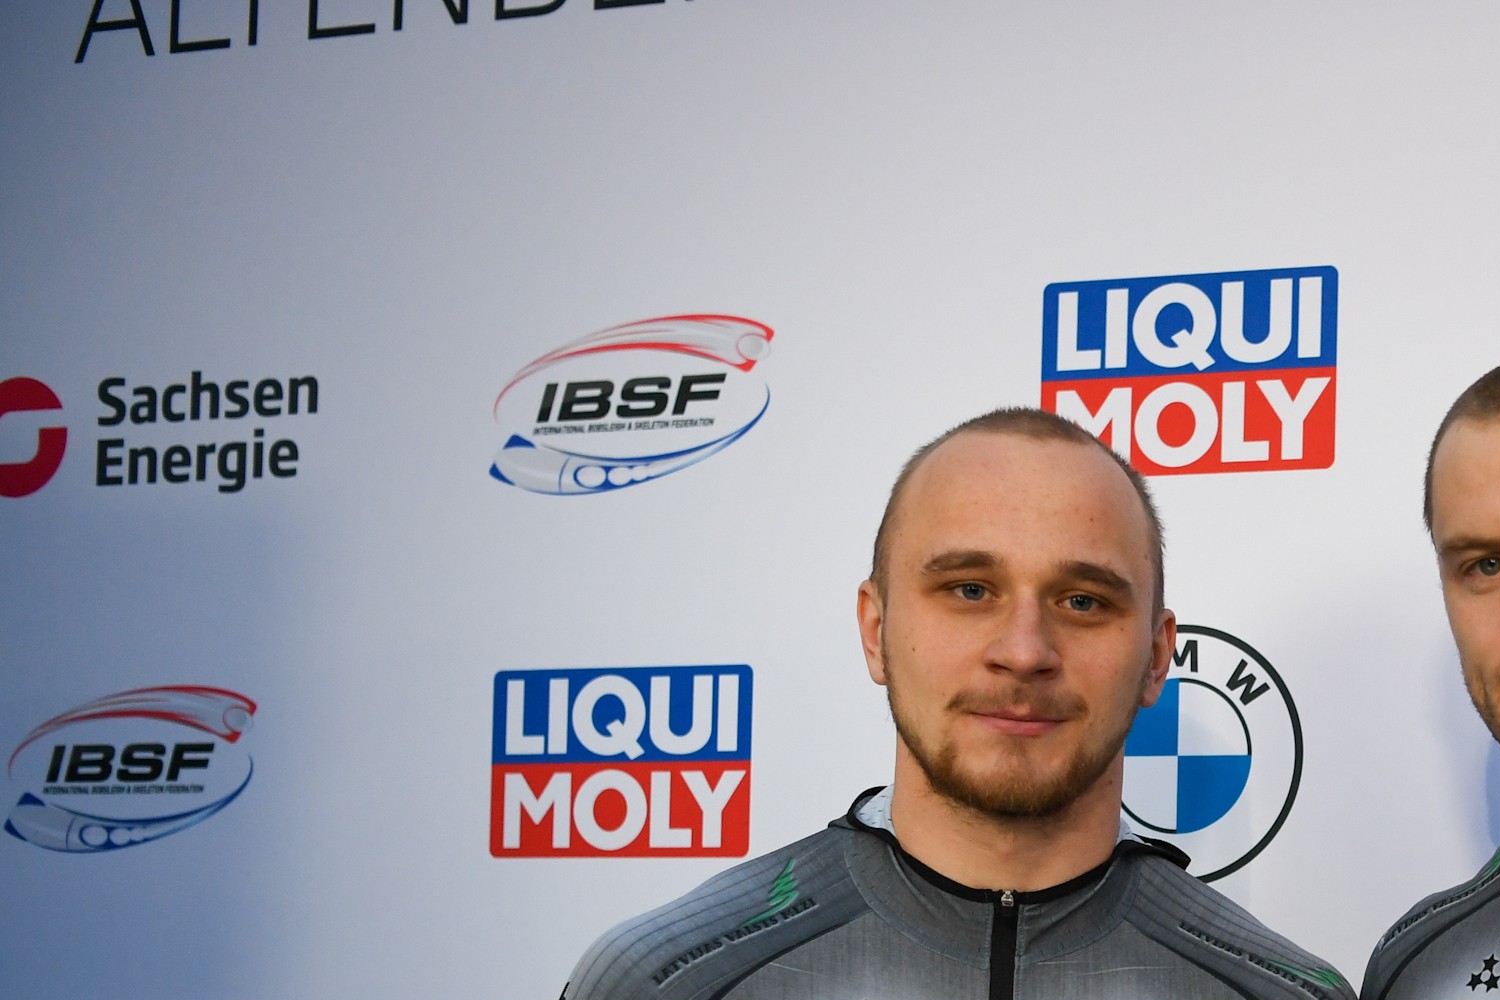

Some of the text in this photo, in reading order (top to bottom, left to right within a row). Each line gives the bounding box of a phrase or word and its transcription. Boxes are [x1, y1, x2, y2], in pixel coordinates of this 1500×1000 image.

[1056, 276, 1323, 371] LIQUI
[98, 370, 319, 426] Sachsen
[536, 373, 727, 423] IBSF
[1056, 377, 1332, 468] MOLY
[96, 428, 299, 493] Energie
[1172, 640, 1271, 706] MW
[505, 674, 740, 760] LIQUI
[46, 742, 215, 783] IBSF
[503, 770, 748, 850] MOLY
